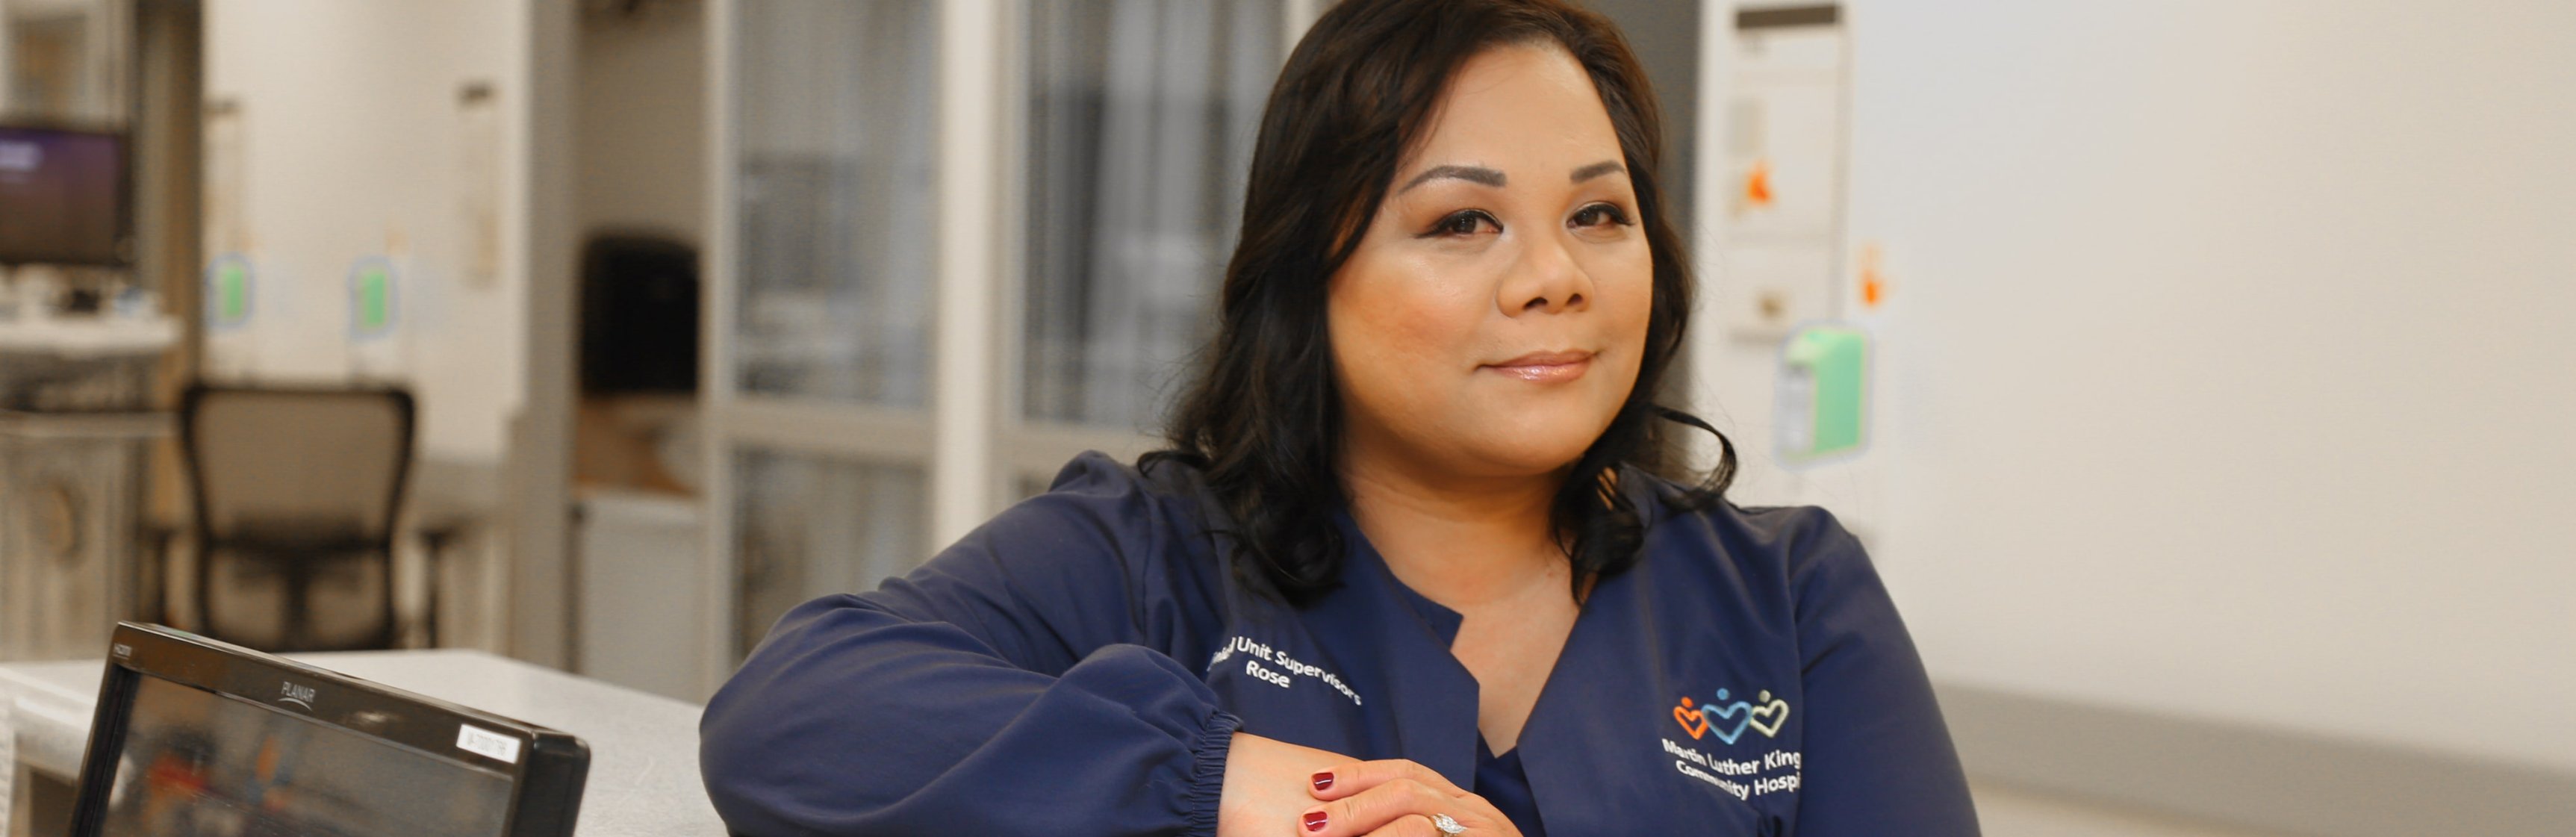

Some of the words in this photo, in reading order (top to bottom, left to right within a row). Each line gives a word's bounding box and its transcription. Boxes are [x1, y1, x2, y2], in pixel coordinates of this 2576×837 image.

[1237, 636, 1272, 661] Unit
[1275, 651, 1362, 706] Supervisors
[1246, 660, 1290, 688] Rose
[281, 681, 315, 703] PLANAR
[1662, 738, 1707, 767] Martin
[1707, 753, 1760, 775] Luther
[1764, 750, 1802, 771] King
[1676, 760, 1749, 800] Community
